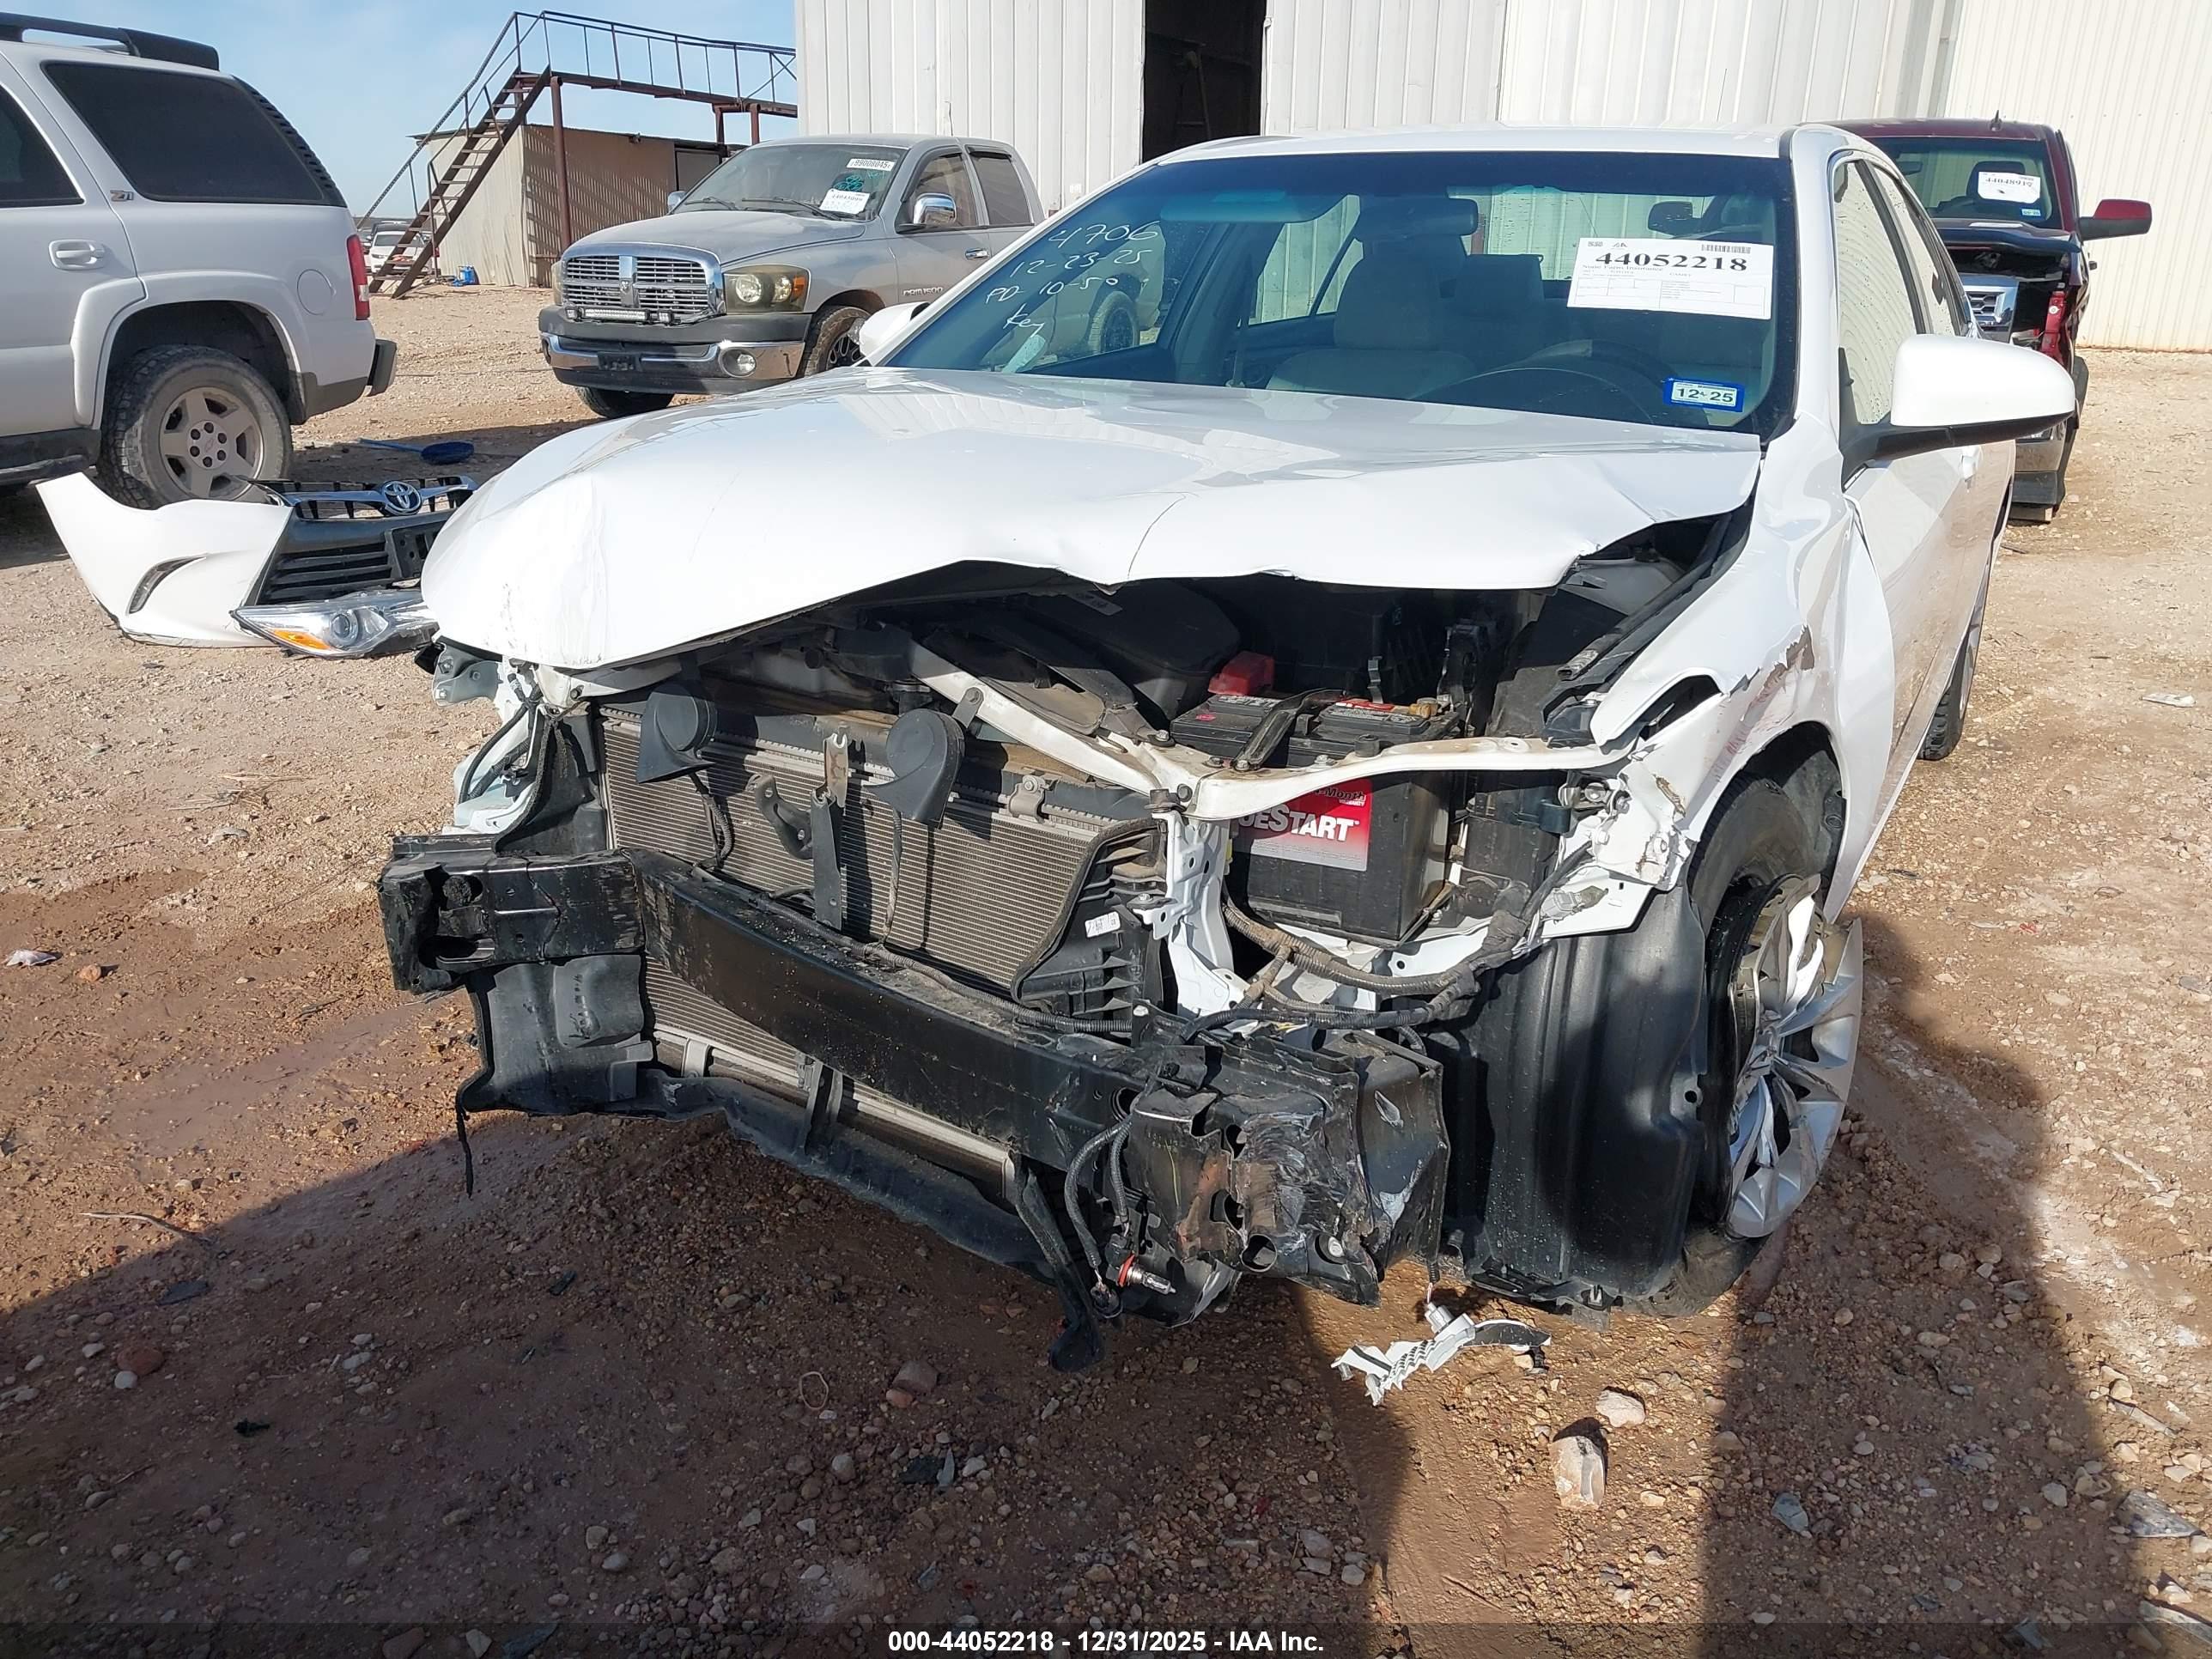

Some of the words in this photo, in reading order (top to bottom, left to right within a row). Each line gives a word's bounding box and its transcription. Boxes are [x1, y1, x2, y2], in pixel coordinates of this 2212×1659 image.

[1595, 252, 1747, 271] 44052218
[1678, 388, 1699, 398] 12
[1710, 392, 1734, 403] 25
